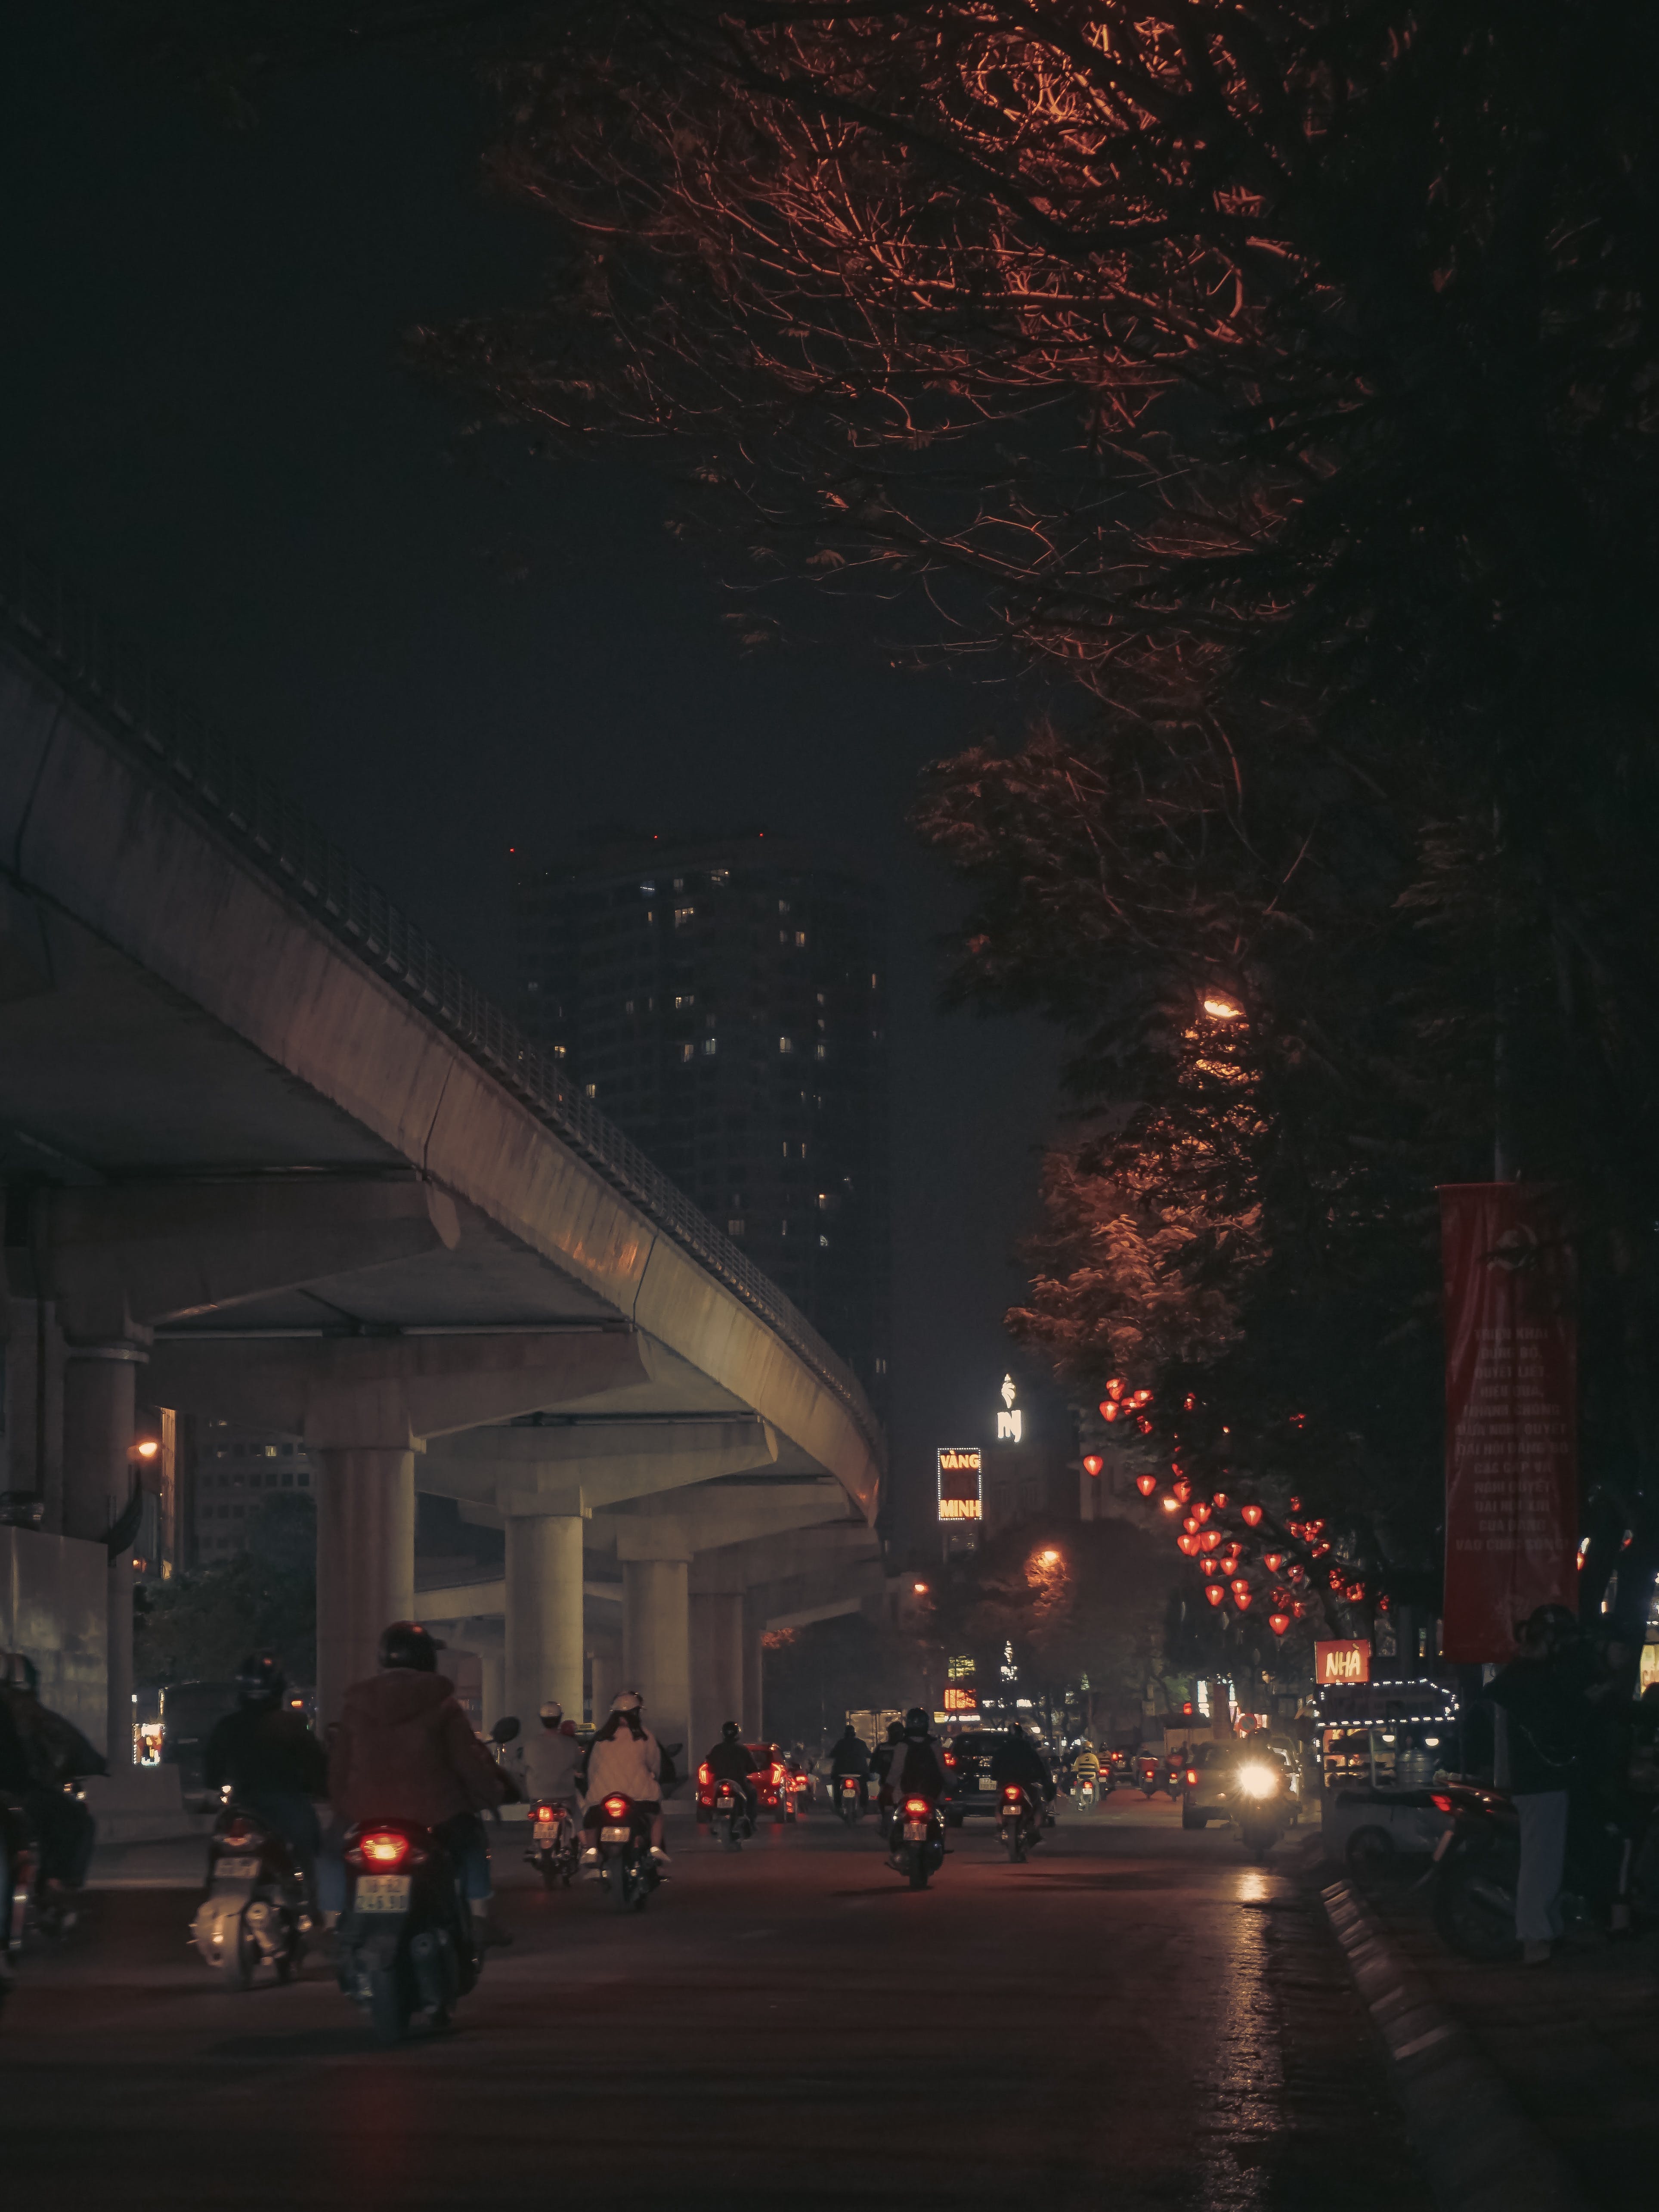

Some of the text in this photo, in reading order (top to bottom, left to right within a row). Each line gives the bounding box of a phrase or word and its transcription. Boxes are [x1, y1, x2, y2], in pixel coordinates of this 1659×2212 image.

[940, 1450, 979, 1468] VÀNG
[940, 1500, 980, 1517] MINH
[1326, 1643, 1360, 1677] NHÀ
